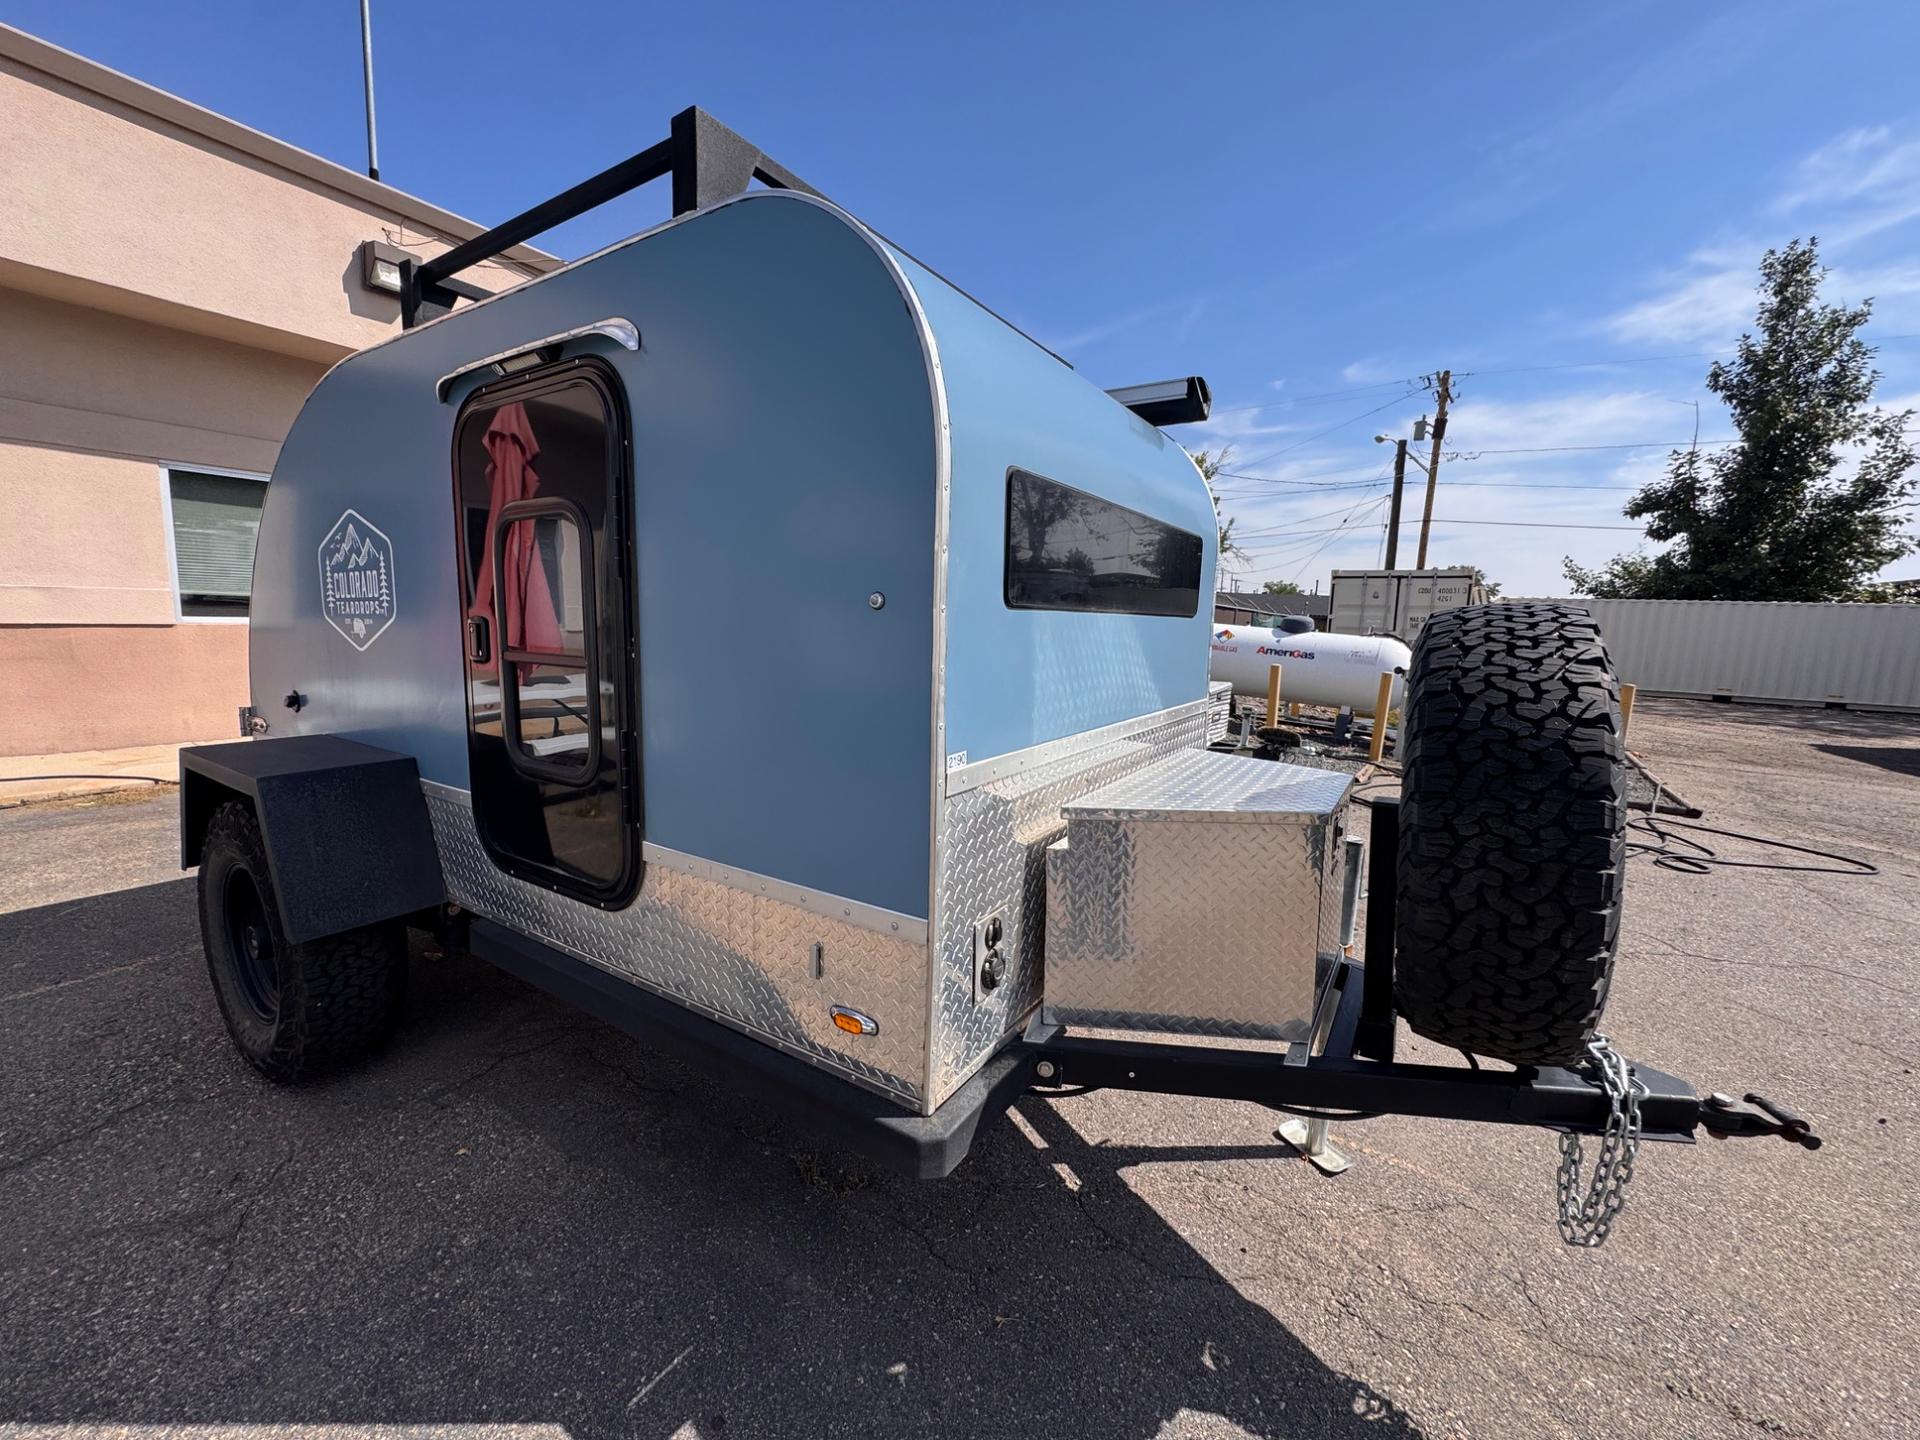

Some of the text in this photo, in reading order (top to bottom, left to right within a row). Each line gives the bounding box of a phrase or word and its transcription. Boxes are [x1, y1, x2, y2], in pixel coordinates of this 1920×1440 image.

[333, 570, 379, 598] COLORADO
[336, 601, 379, 614] TEARDROPS
[1256, 646, 1315, 660] AmeriGas
[949, 753, 966, 768] 2190
